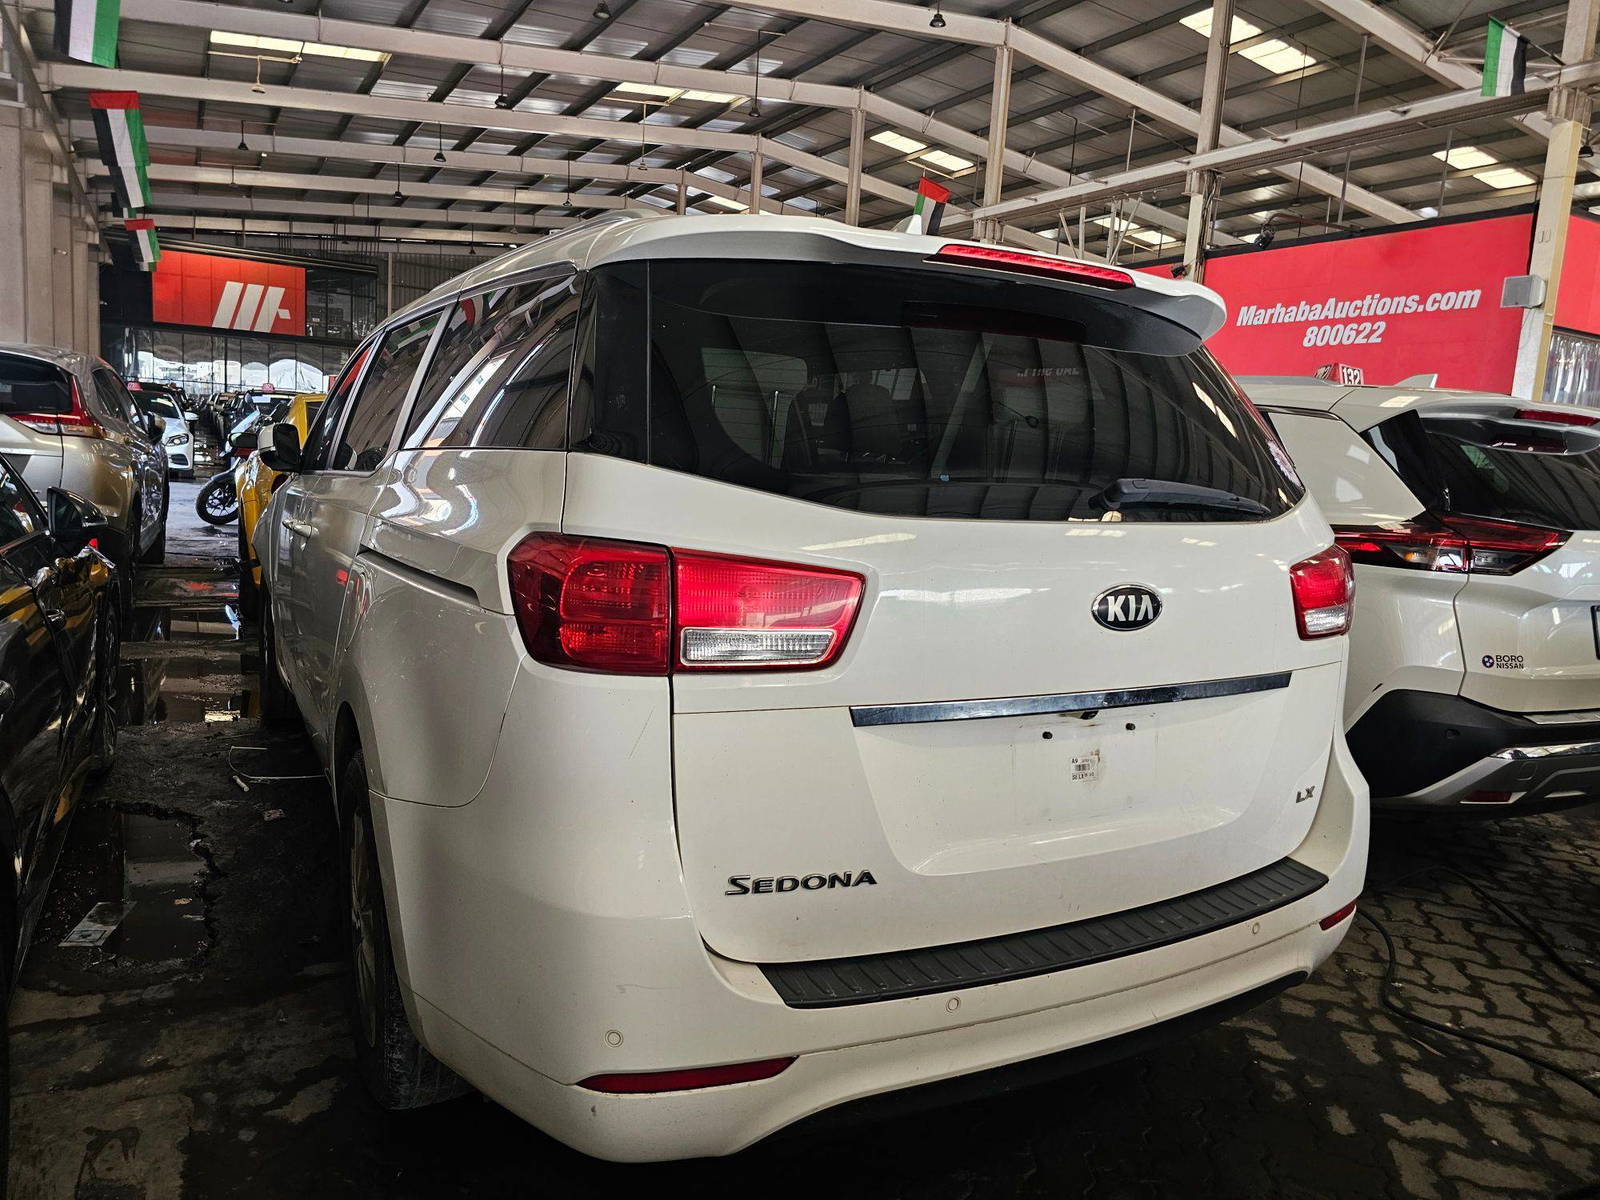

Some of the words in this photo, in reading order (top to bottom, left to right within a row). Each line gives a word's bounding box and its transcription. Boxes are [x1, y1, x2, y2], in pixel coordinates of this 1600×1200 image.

[1236, 289, 1482, 327] MarhabaAuctions.com
[1303, 321, 1387, 348] 800622
[1342, 367, 1361, 385] 132
[1106, 594, 1154, 622] KIA
[1496, 662, 1524, 670] NISSAN
[1295, 785, 1316, 804] LX
[725, 869, 878, 896] SEDONA
